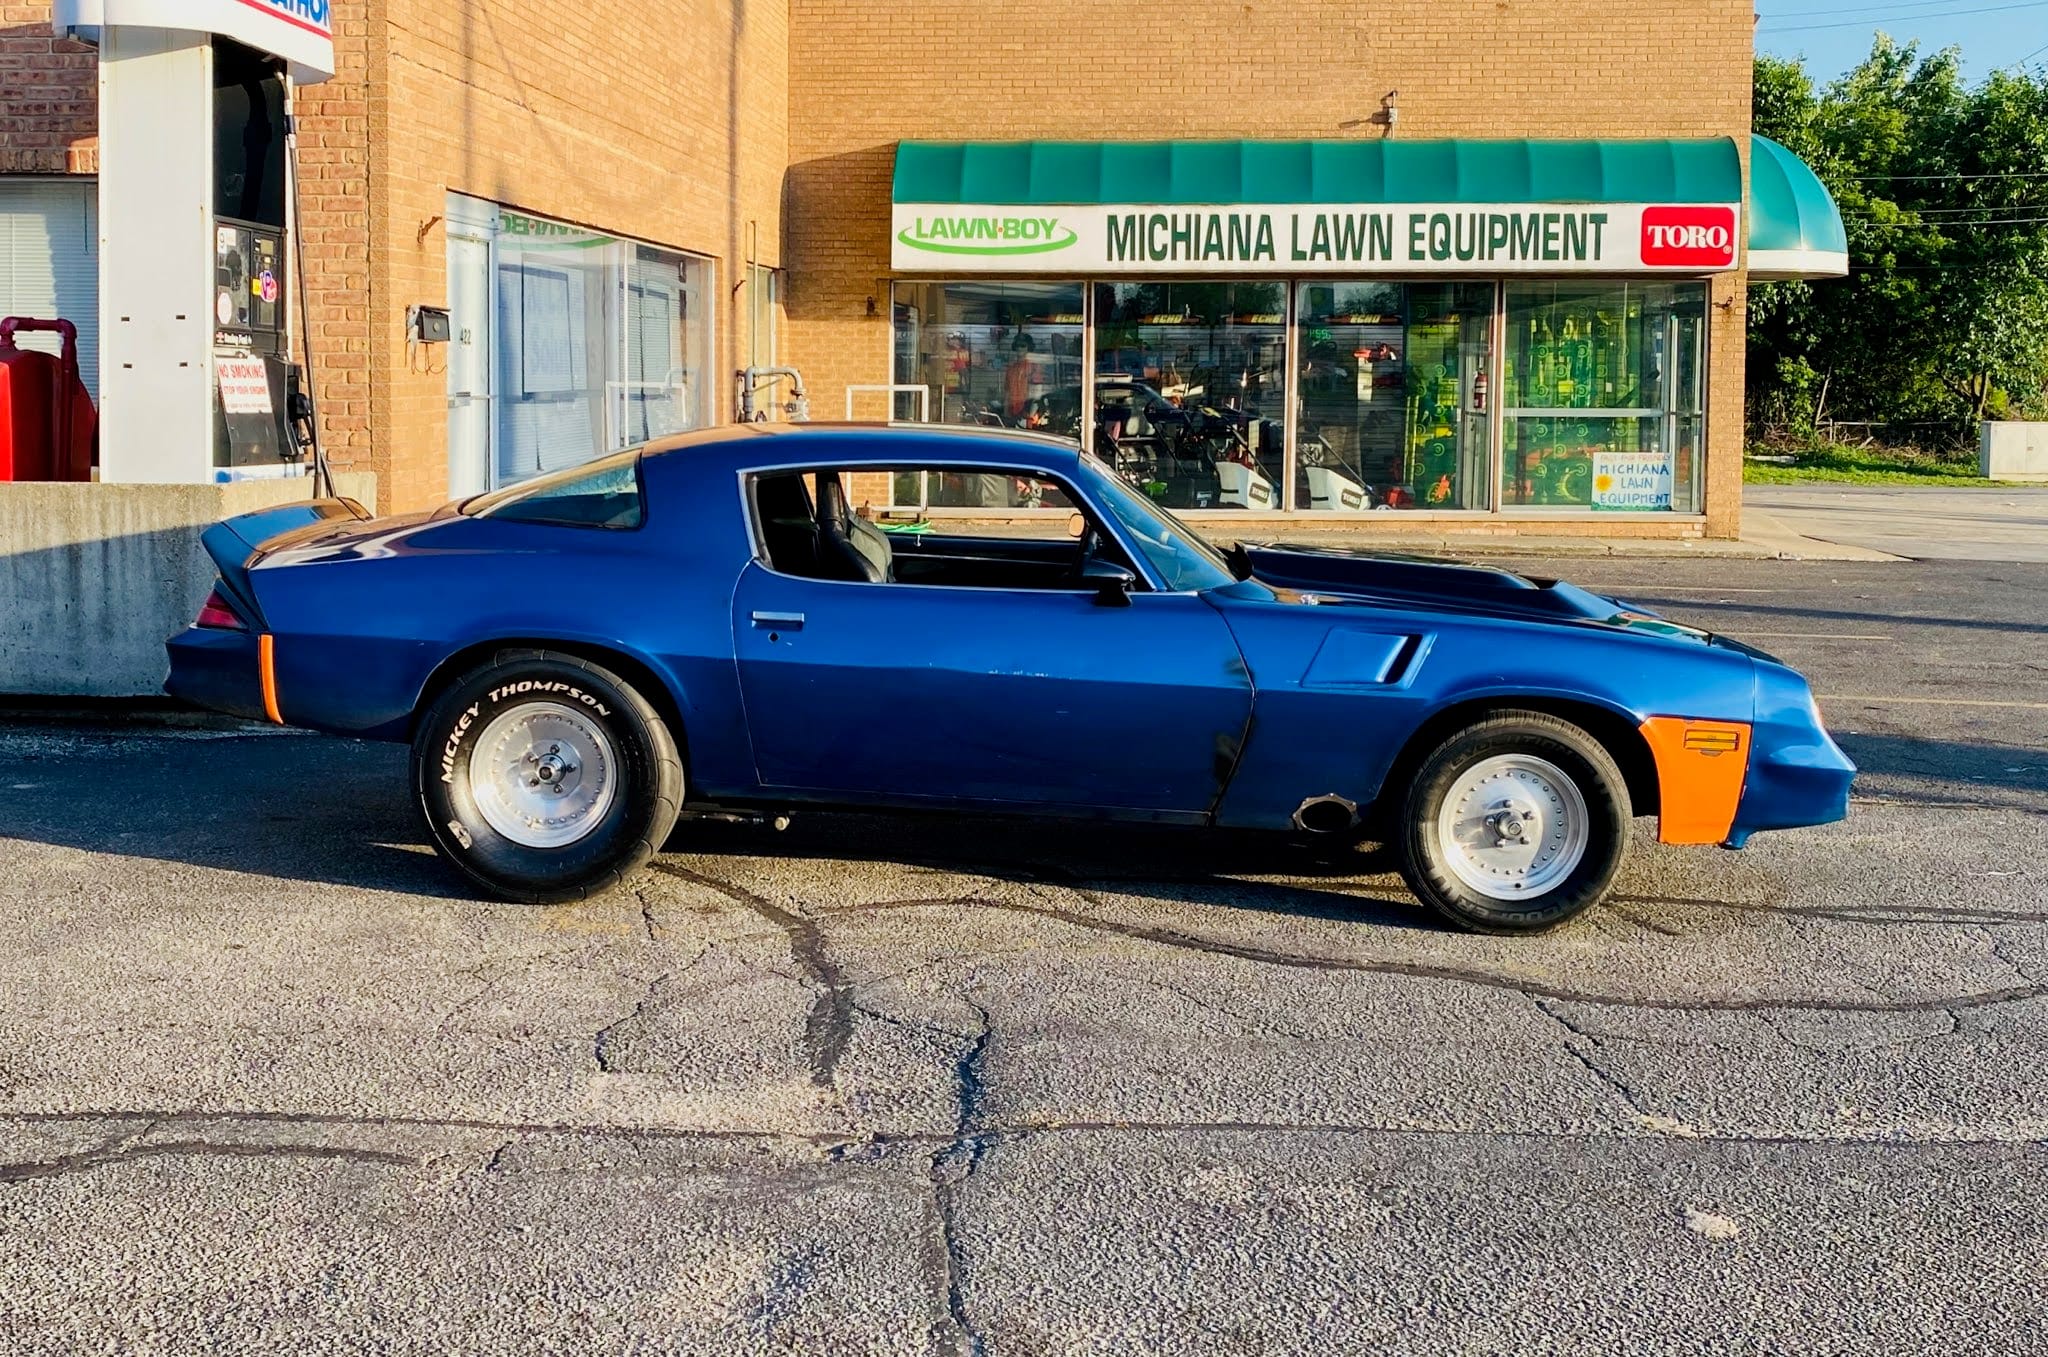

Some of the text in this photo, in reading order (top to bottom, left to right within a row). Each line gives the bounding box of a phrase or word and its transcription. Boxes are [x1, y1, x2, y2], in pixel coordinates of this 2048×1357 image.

[1107, 213, 1608, 262] MICHIANA LAWN EQUIPMENT
[1153, 314, 1183, 324] ECHO
[1251, 314, 1282, 324] ECHO
[1350, 313, 1380, 324] ECHO
[218, 363, 265, 378] NO SMOKING
[1600, 464, 1669, 475] MICHIANA
[1621, 477, 1653, 489] LAWN
[1600, 493, 1671, 504] EQUIPMENT
[441, 680, 611, 784] MICKEY THOMPSON
